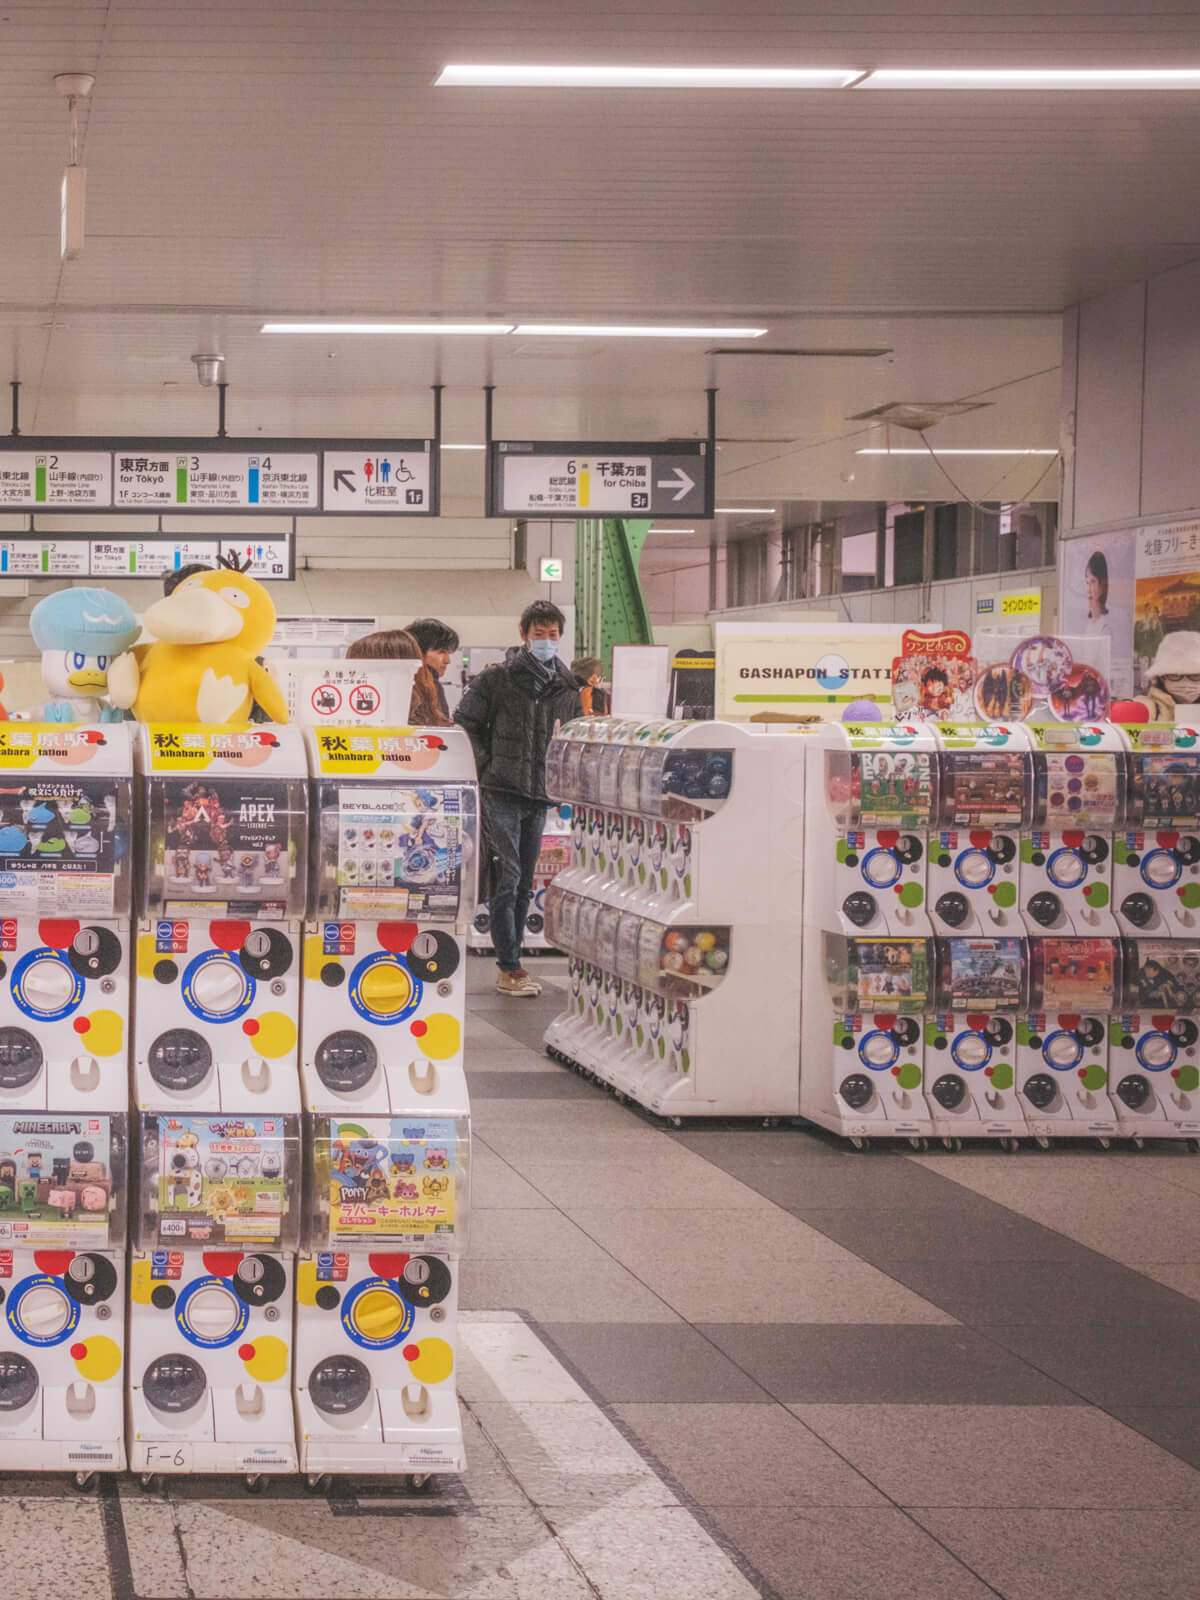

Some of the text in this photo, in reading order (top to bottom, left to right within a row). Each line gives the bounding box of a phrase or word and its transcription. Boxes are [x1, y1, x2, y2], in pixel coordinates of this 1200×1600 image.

[49, 456, 59, 470] 2
[120, 458, 169, 472] 東京方面
[190, 457, 200, 470] 3
[262, 456, 272, 470] 4
[567, 460, 577, 474] 6
[596, 462, 646, 477] 千葉方面
[120, 474, 133, 483] for
[262, 473, 308, 483] 京浜東北線
[549, 477, 577, 486] 総武線
[603, 479, 646, 488] for Chiba
[49, 489, 97, 498] 上野・池袋方面
[190, 490, 238, 499] 東京・品川方面
[262, 490, 309, 499] 東京・横浜方面
[364, 486, 397, 497] 化粧室
[408, 490, 422, 504] 1F
[632, 494, 647, 508] 3F
[50, 544, 57, 552] 2
[94, 544, 125, 554] 東京方面
[138, 544, 144, 552] 3
[182, 544, 189, 552] 4
[1003, 599, 1040, 613] コインロッカー
[739, 667, 827, 680] GASHAPON
[153, 733, 262, 749] 秋葉原駅
[320, 735, 429, 752] 秋葉原駅
[32, 747, 68, 757] Station
[153, 749, 243, 759] Akihabara Station
[321, 752, 412, 762] Akihabara Station
[240, 803, 276, 823] APEX
[12, 1121, 82, 1135] MINECRAFT
[341, 1205, 446, 1217] ラバーキーホルダー
[146, 1446, 186, 1466] F-6
